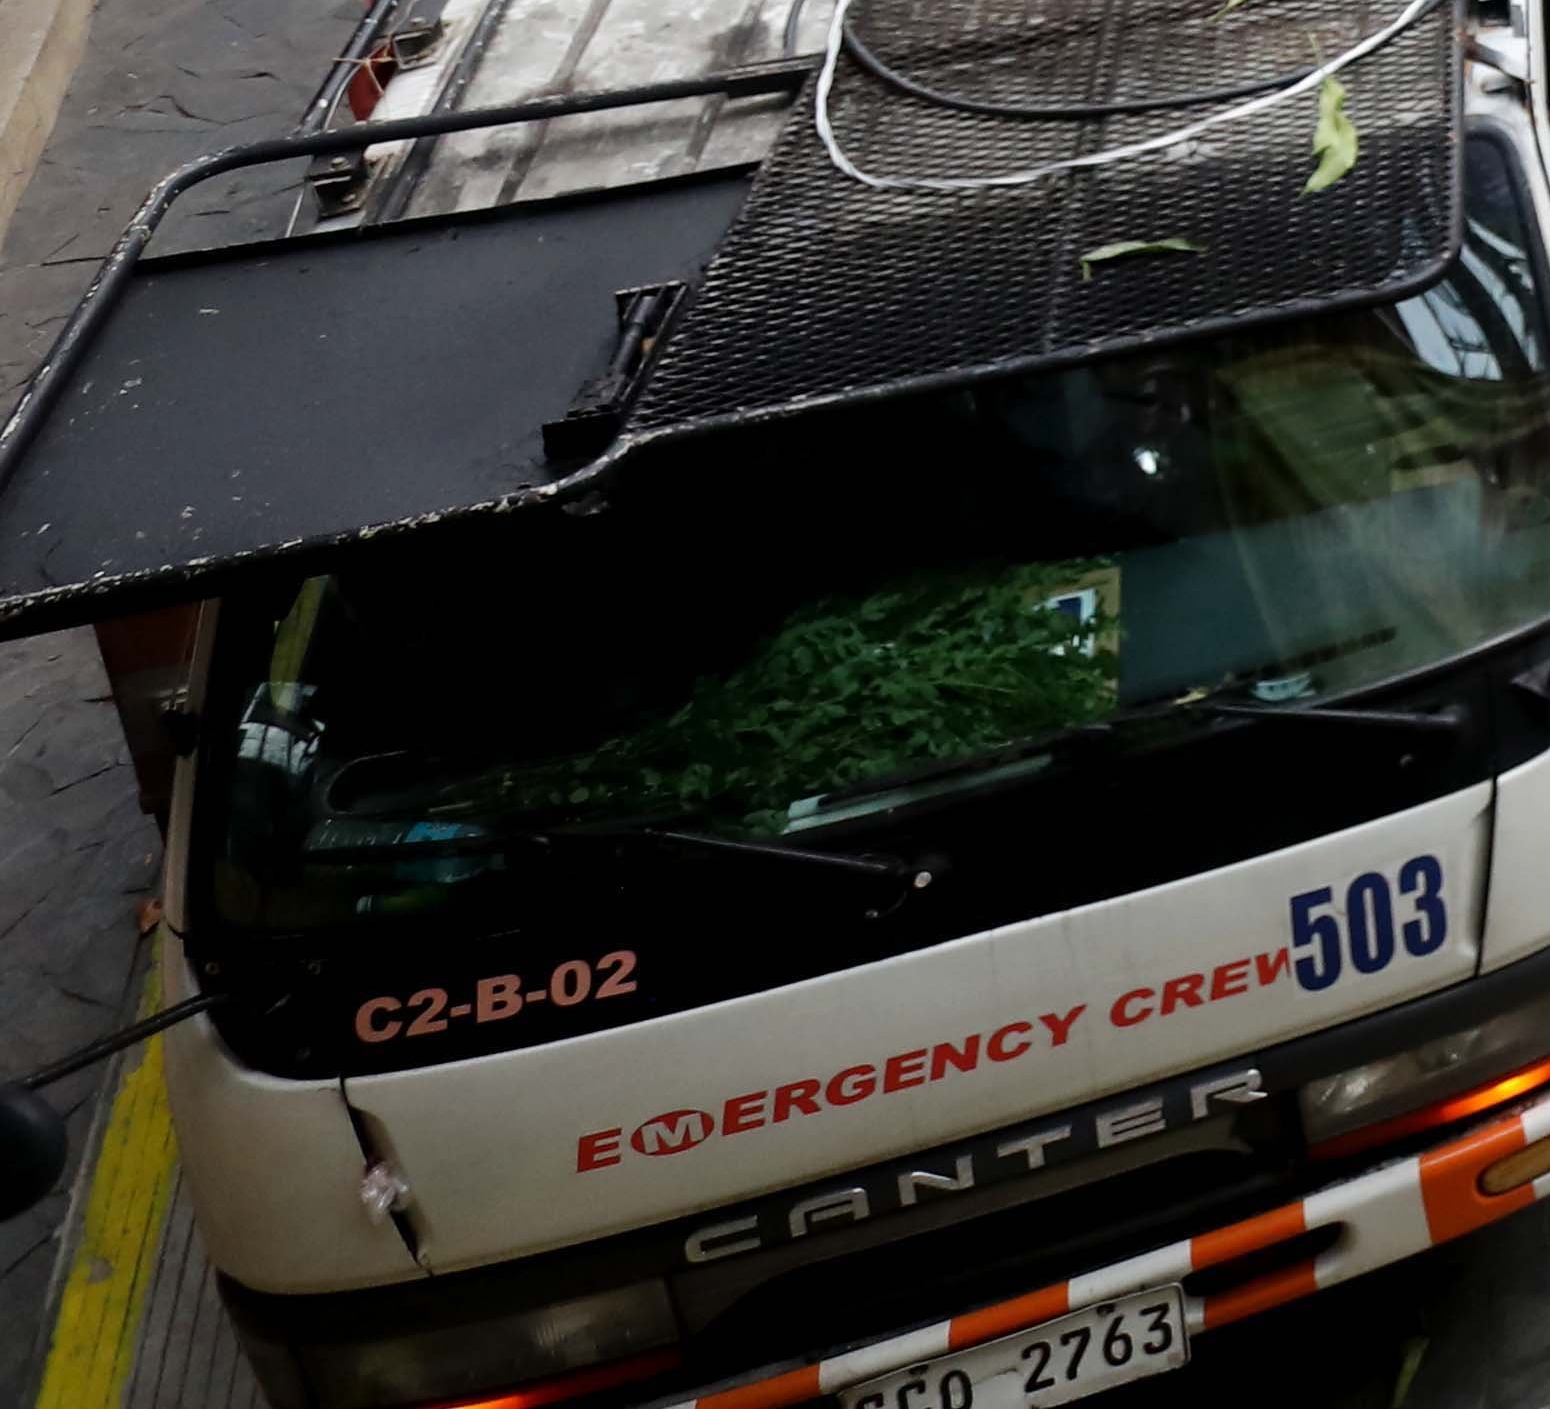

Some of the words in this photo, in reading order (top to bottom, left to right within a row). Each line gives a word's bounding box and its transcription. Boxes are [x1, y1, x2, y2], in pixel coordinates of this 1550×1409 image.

[1290, 854, 1450, 995] 503
[352, 948, 642, 1044] C2-B-02
[574, 1003, 1088, 1176] EMERGENCY
[684, 1065, 1271, 1266] CANTER
[1020, 1302, 1174, 1393] 2763
